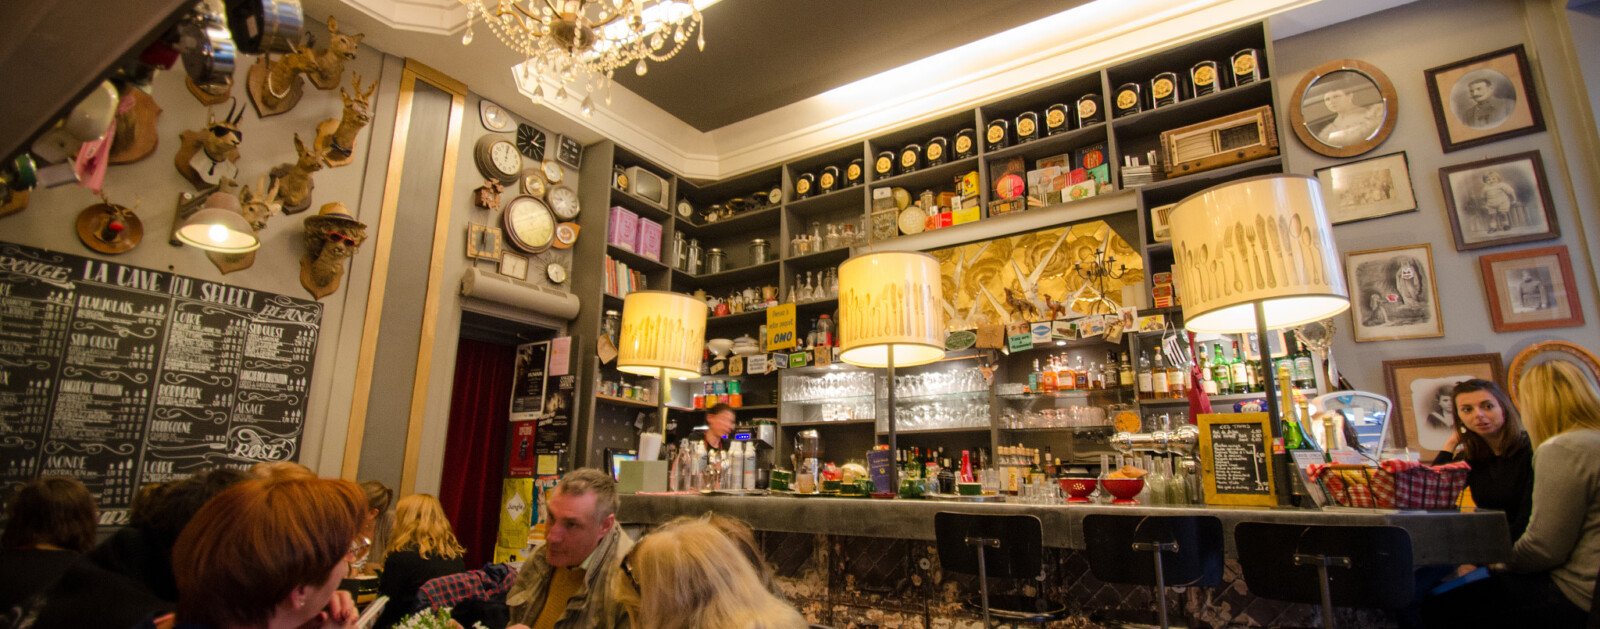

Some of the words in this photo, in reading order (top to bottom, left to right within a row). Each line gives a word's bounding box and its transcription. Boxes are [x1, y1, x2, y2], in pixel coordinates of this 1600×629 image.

[83, 260, 108, 283] LA
[117, 265, 163, 291] CAVE
[169, 275, 194, 297] DU
[200, 282, 257, 309] SELECT
[774, 331, 793, 344] OMO
[235, 402, 266, 415] ALSACE
